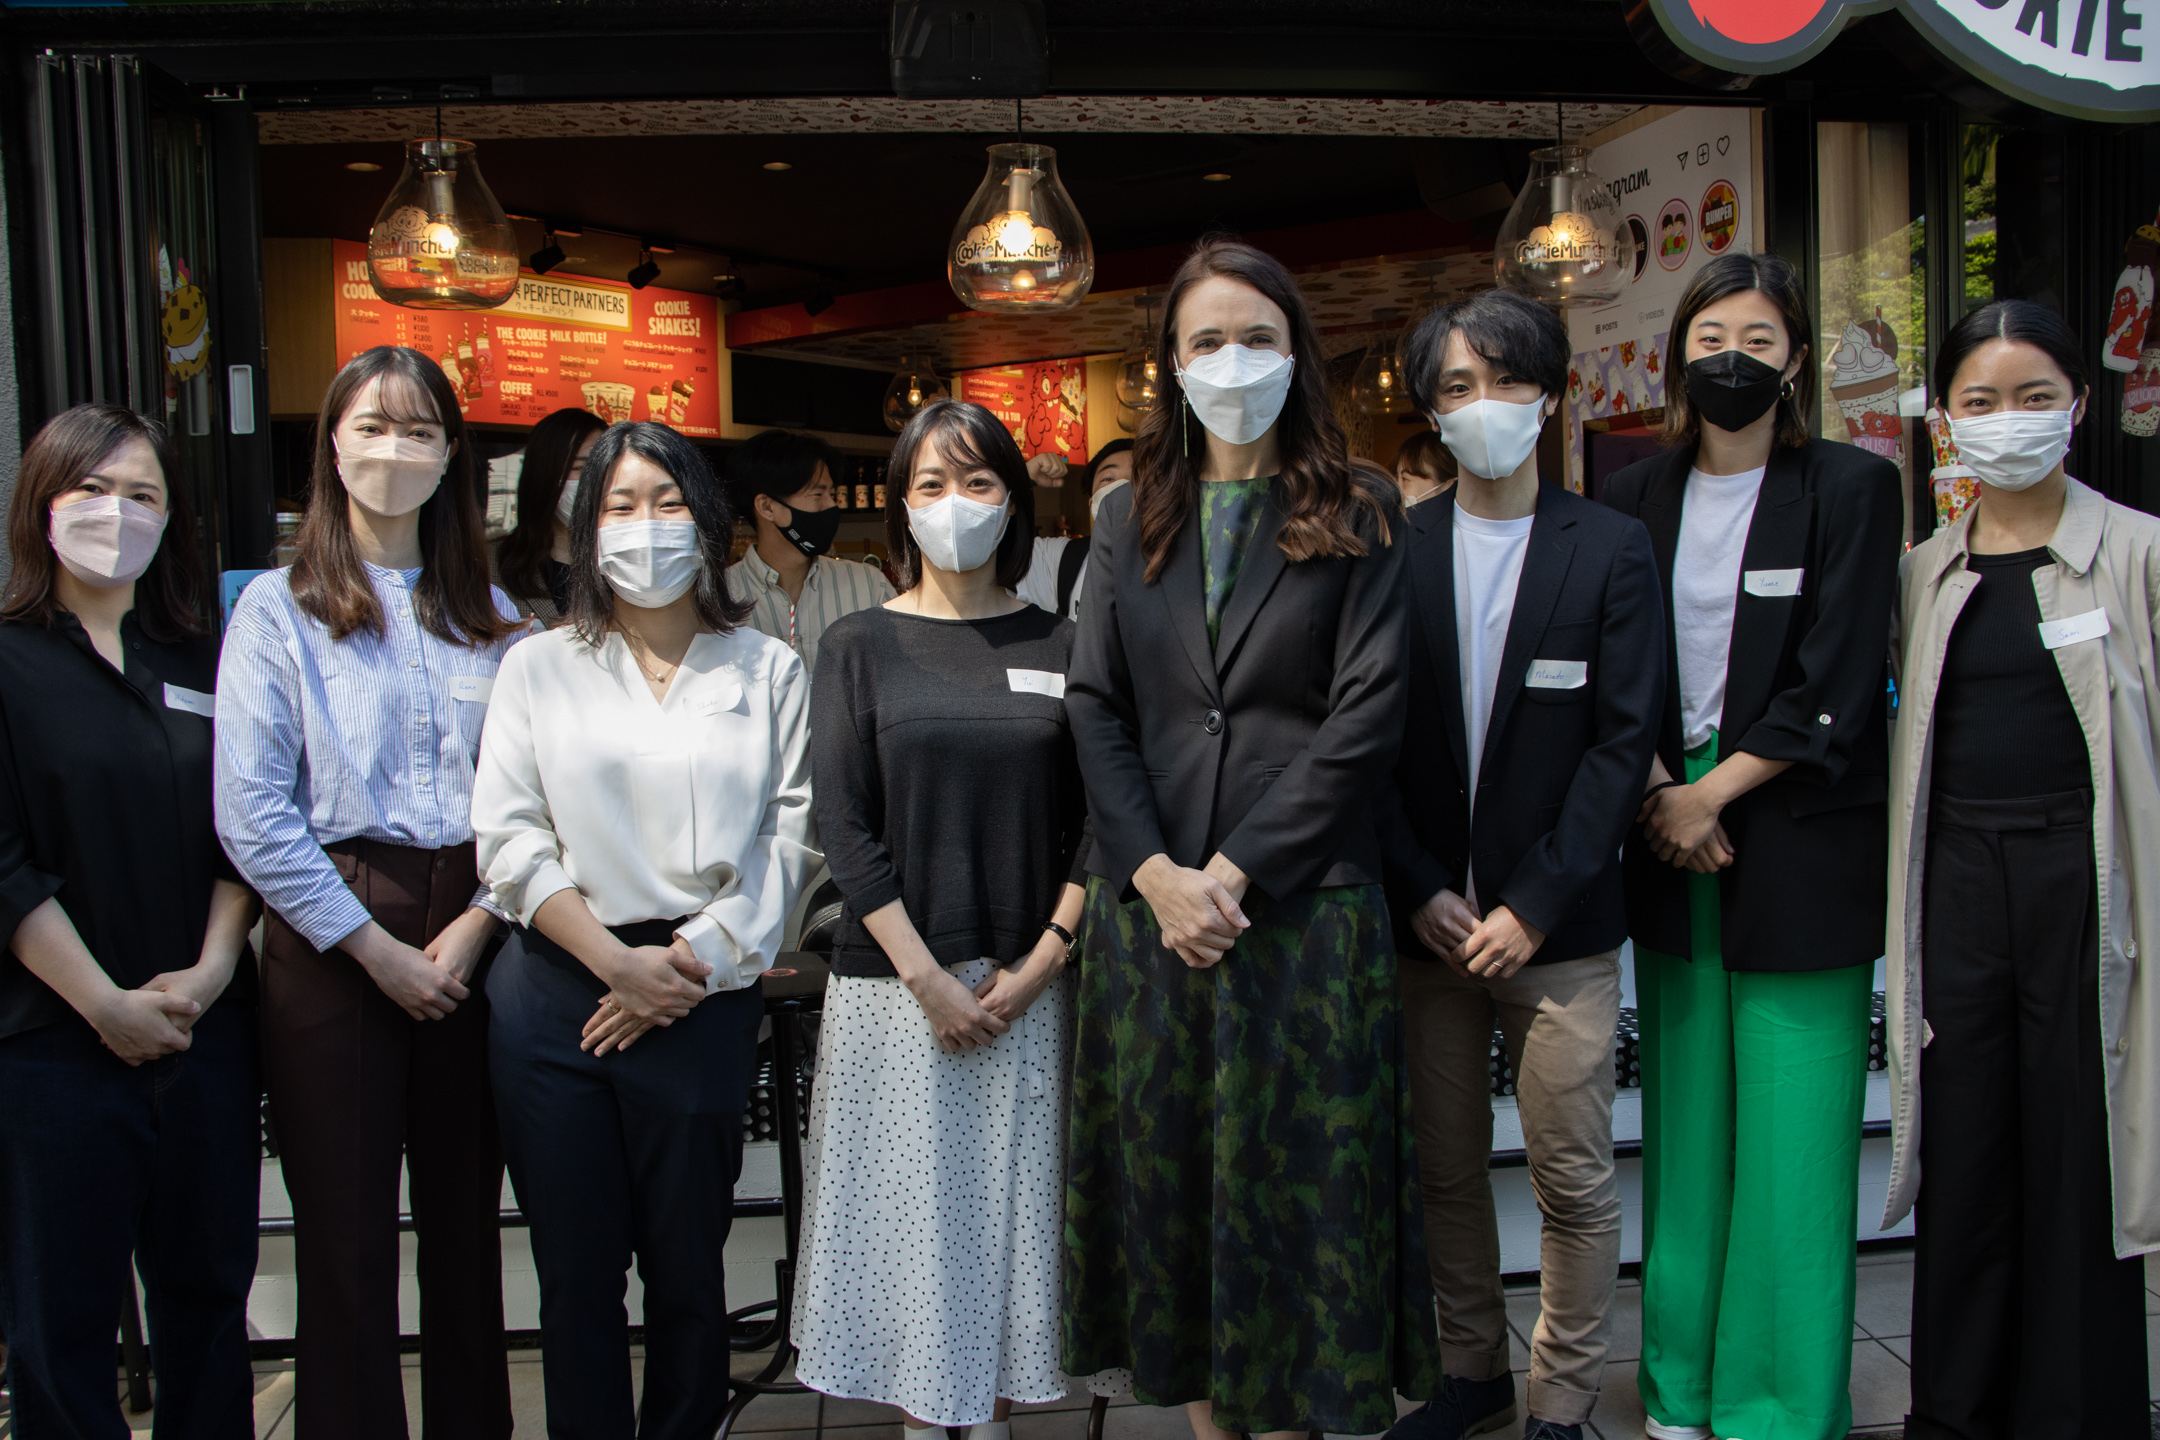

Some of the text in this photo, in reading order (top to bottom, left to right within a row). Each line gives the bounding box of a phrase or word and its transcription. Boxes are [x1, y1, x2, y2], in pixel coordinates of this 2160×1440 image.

[1974, 0, 2143, 62] KIE
[1705, 202, 1734, 227] BUMPER
[346, 261, 368, 281] HO
[523, 283, 572, 306] PERFECT
[573, 290, 625, 314] PARTNERS
[654, 301, 691, 316] COOKIE
[1645, 308, 1665, 320] VIDEOS
[496, 326, 608, 345] THE COOKIE MILK BOTTLE!
[648, 317, 701, 338] SHAKES!
[1601, 321, 1618, 332] POSTS
[500, 380, 559, 398] COFFEE ALL ¥500
[1534, 669, 1566, 680] Masato
